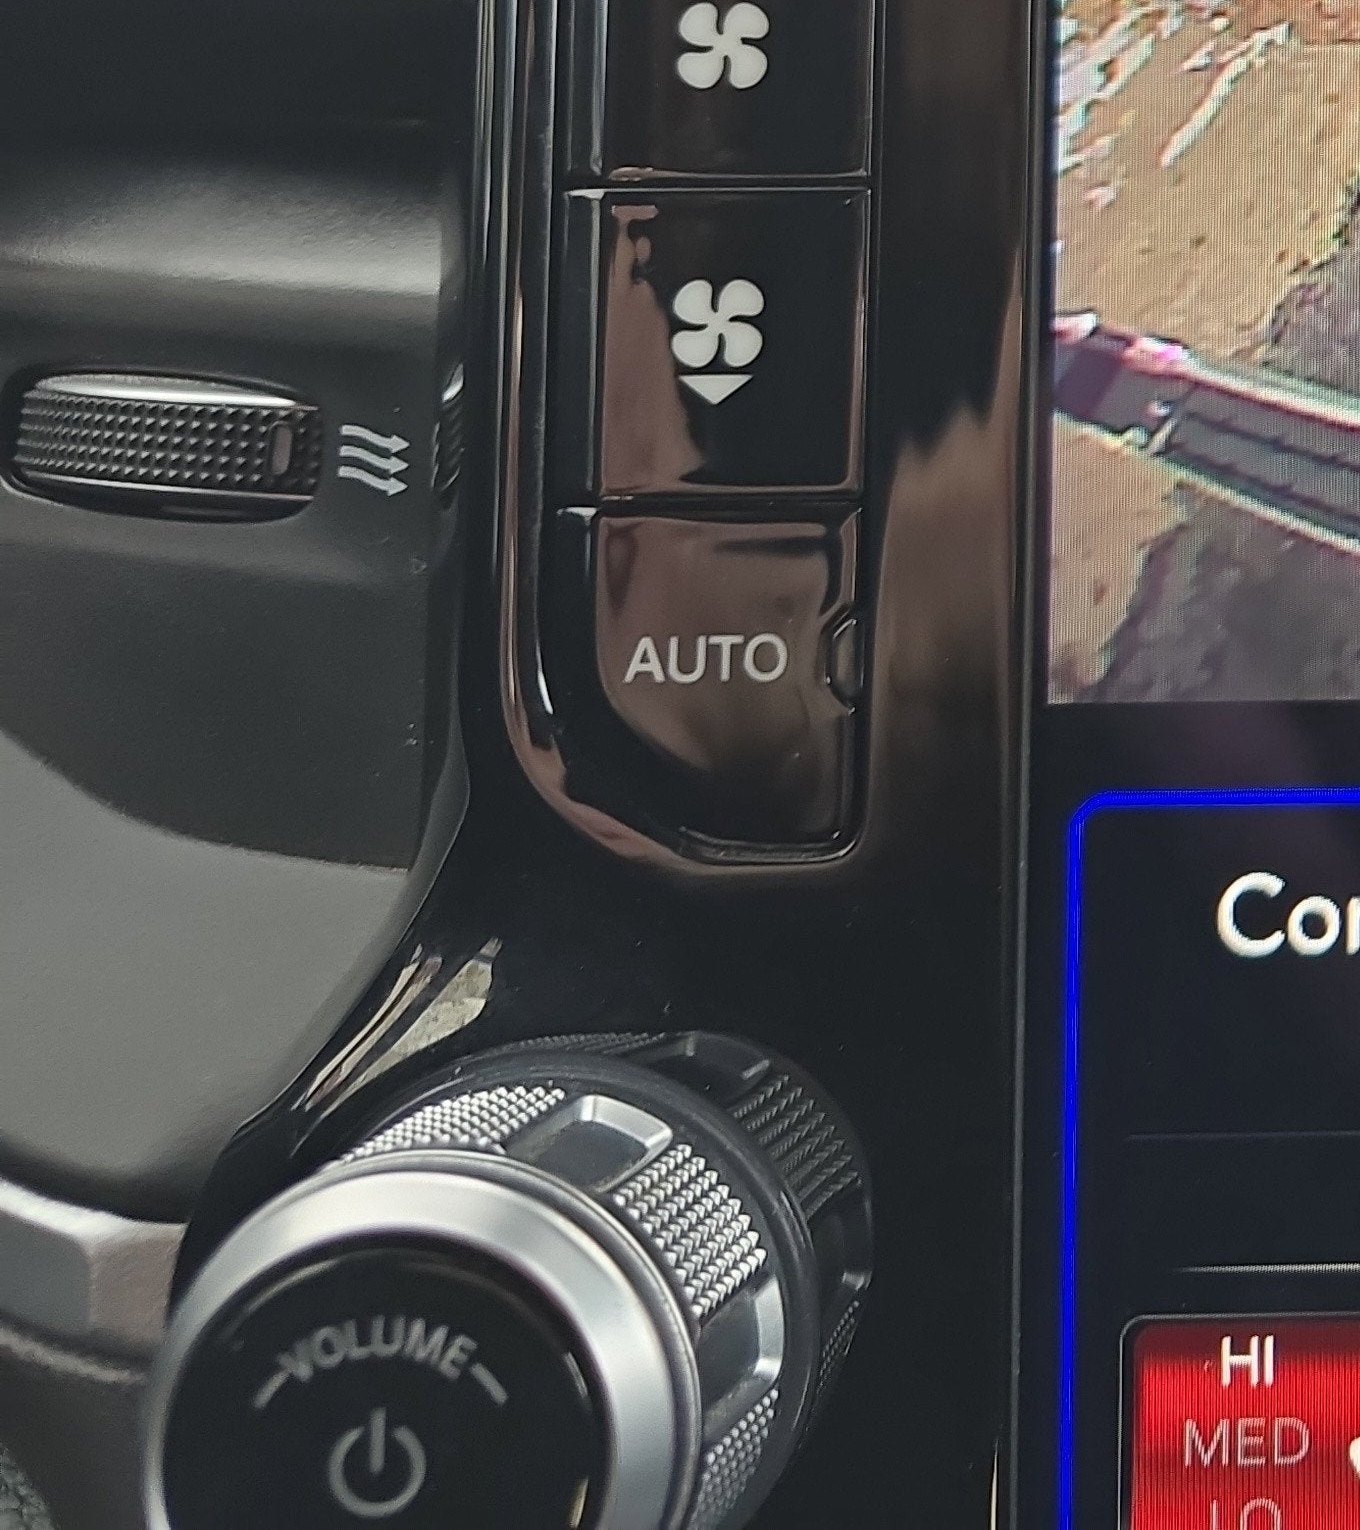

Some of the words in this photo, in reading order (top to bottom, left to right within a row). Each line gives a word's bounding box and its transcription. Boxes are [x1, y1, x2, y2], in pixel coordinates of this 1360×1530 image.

[623, 632, 788, 683] AUTO
[278, 1317, 477, 1383] VOLUME
[1221, 1335, 1275, 1388] HI
[1184, 1416, 1311, 1468] MED
